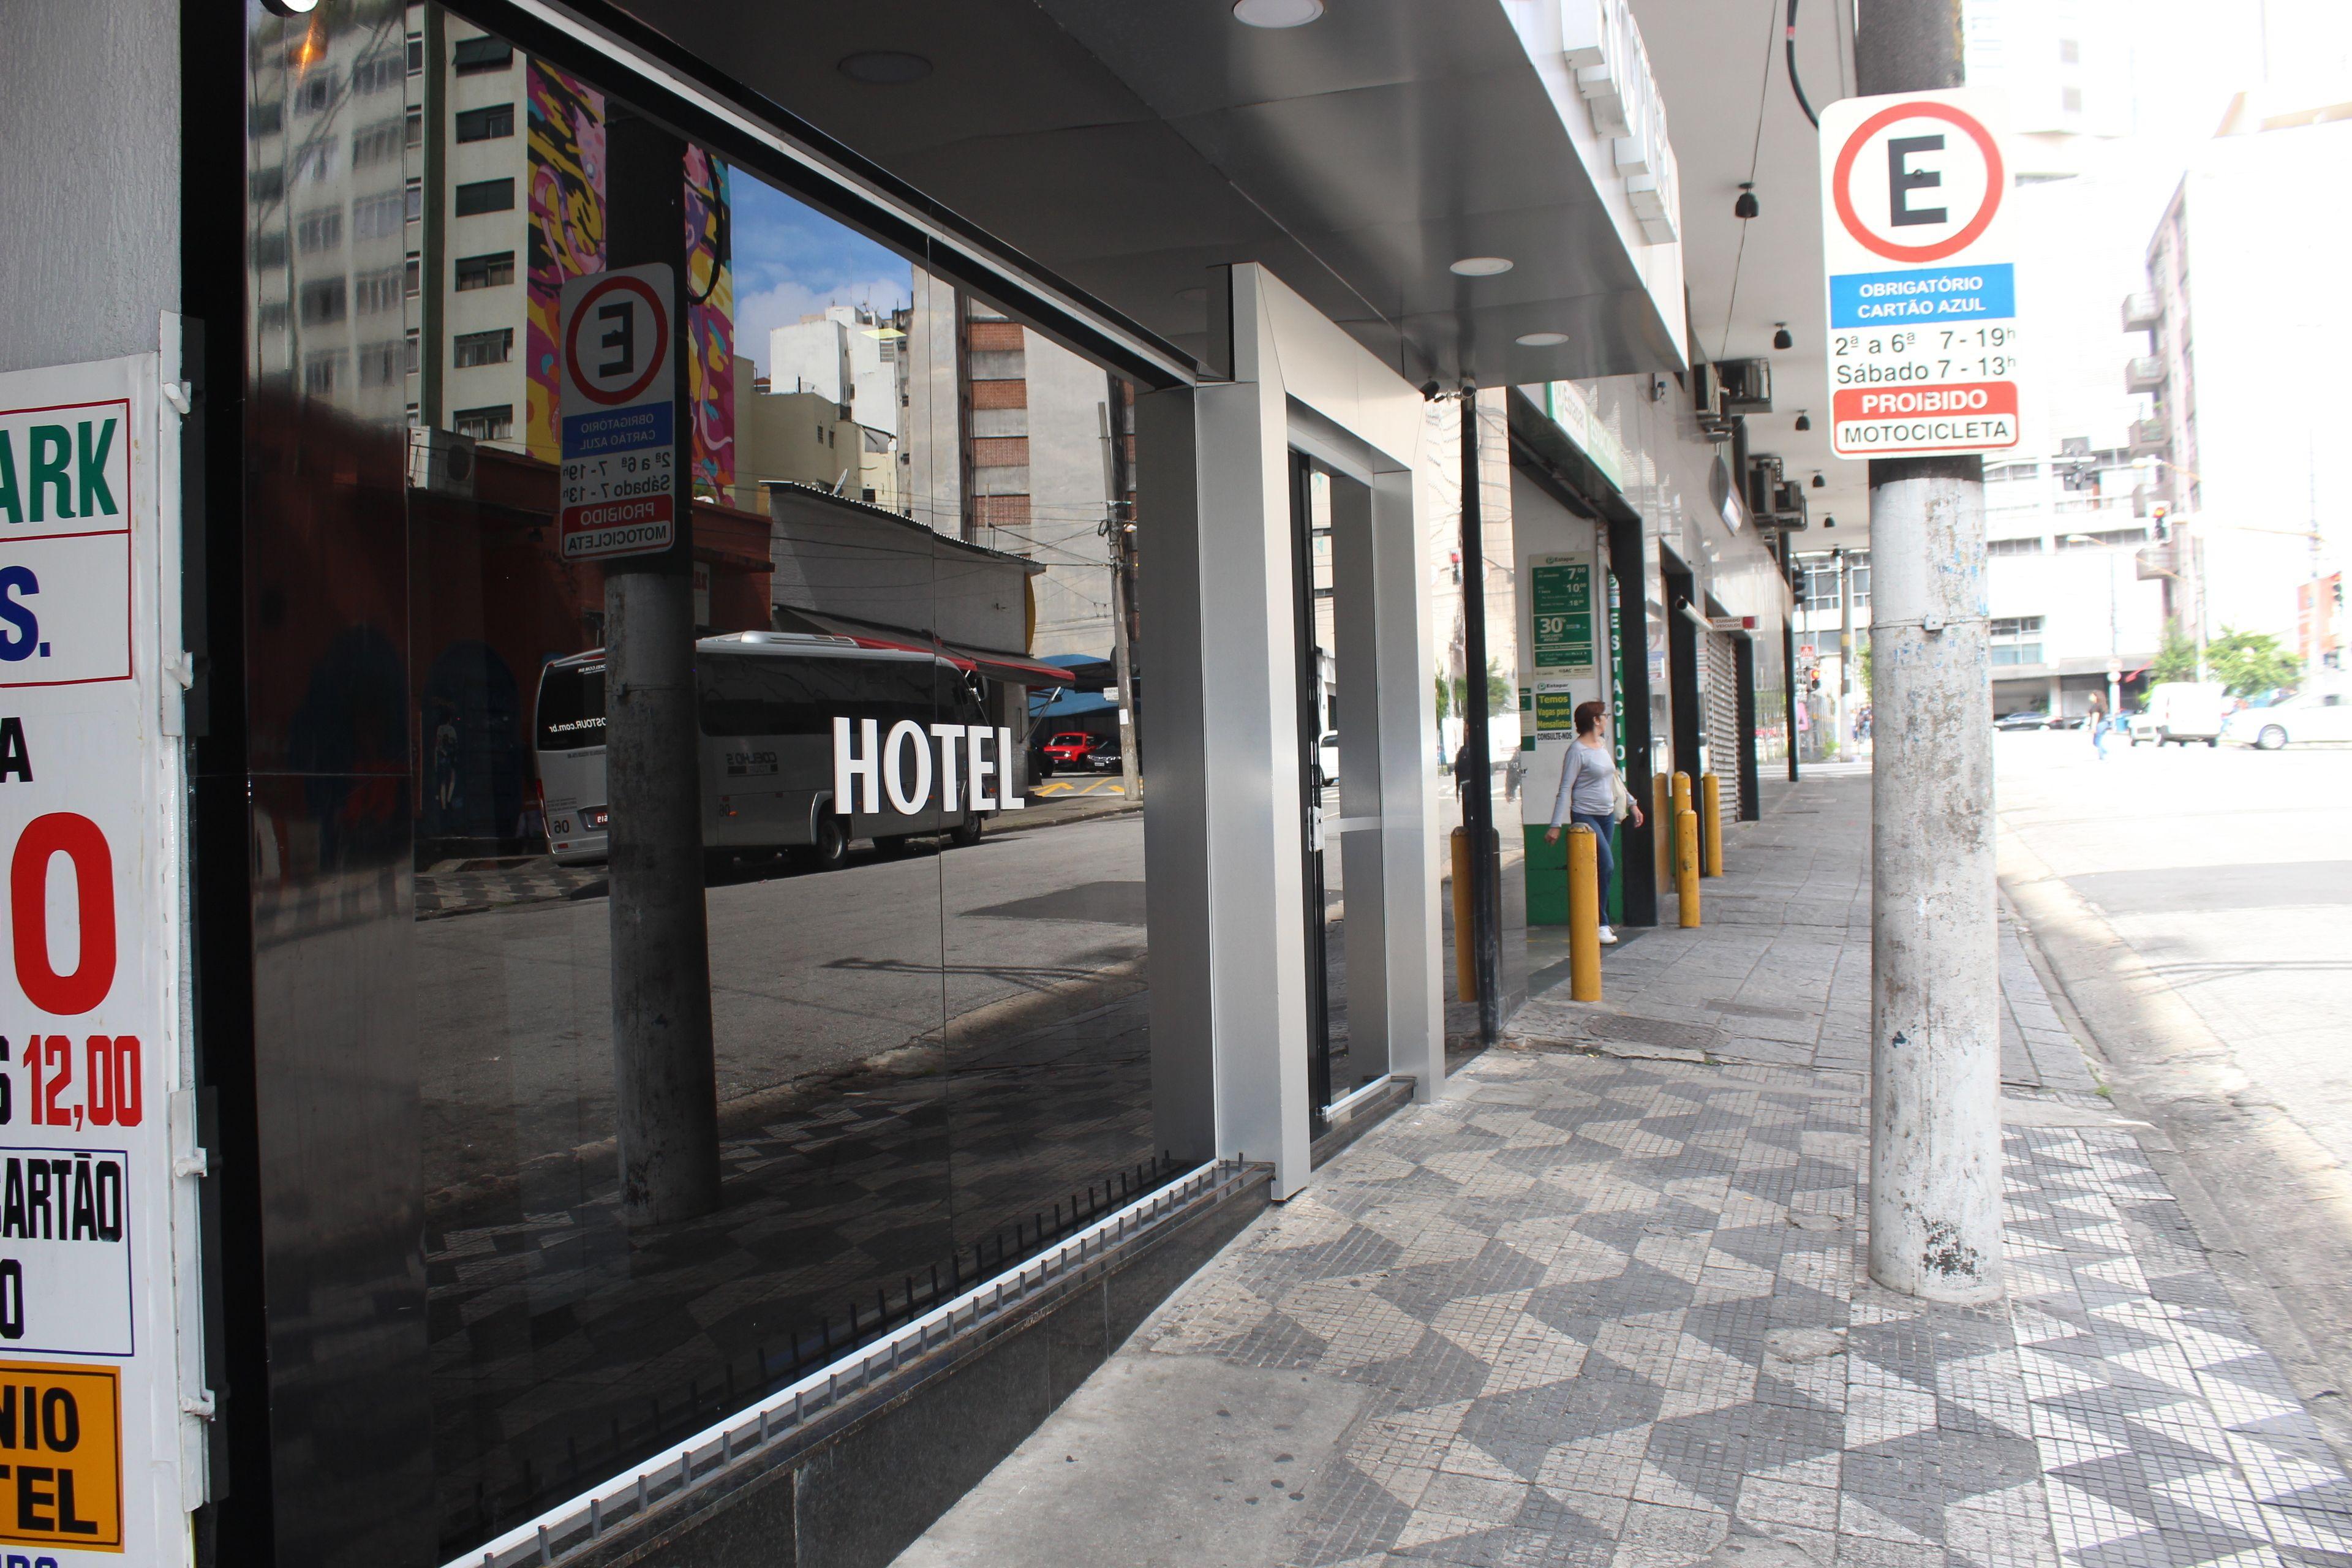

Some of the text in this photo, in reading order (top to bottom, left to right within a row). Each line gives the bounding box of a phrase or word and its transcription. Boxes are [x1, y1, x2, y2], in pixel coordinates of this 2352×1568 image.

[1888, 134, 1947, 227] E
[1860, 276, 1983, 298] OBRIGATÓRIO
[1858, 298, 1986, 318] CARTÃO AZUL
[1868, 339, 1882, 354] a
[1940, 331, 1954, 350] 7
[1837, 361, 1929, 384] Sábado
[1938, 360, 1951, 379] 7
[1862, 389, 1988, 414] PROIBIDO
[1844, 421, 2008, 444] MOTOCICLETA
[1537, 708, 1570, 718] Vagas para
[1537, 719, 1572, 729] Mensalistas
[1537, 732, 1572, 741] CONSULTE-NOS
[833, 717, 1025, 815] HOTEL
[23, 1035, 143, 1132] 12,00
[0, 1152, 123, 1242] ARTÃO
